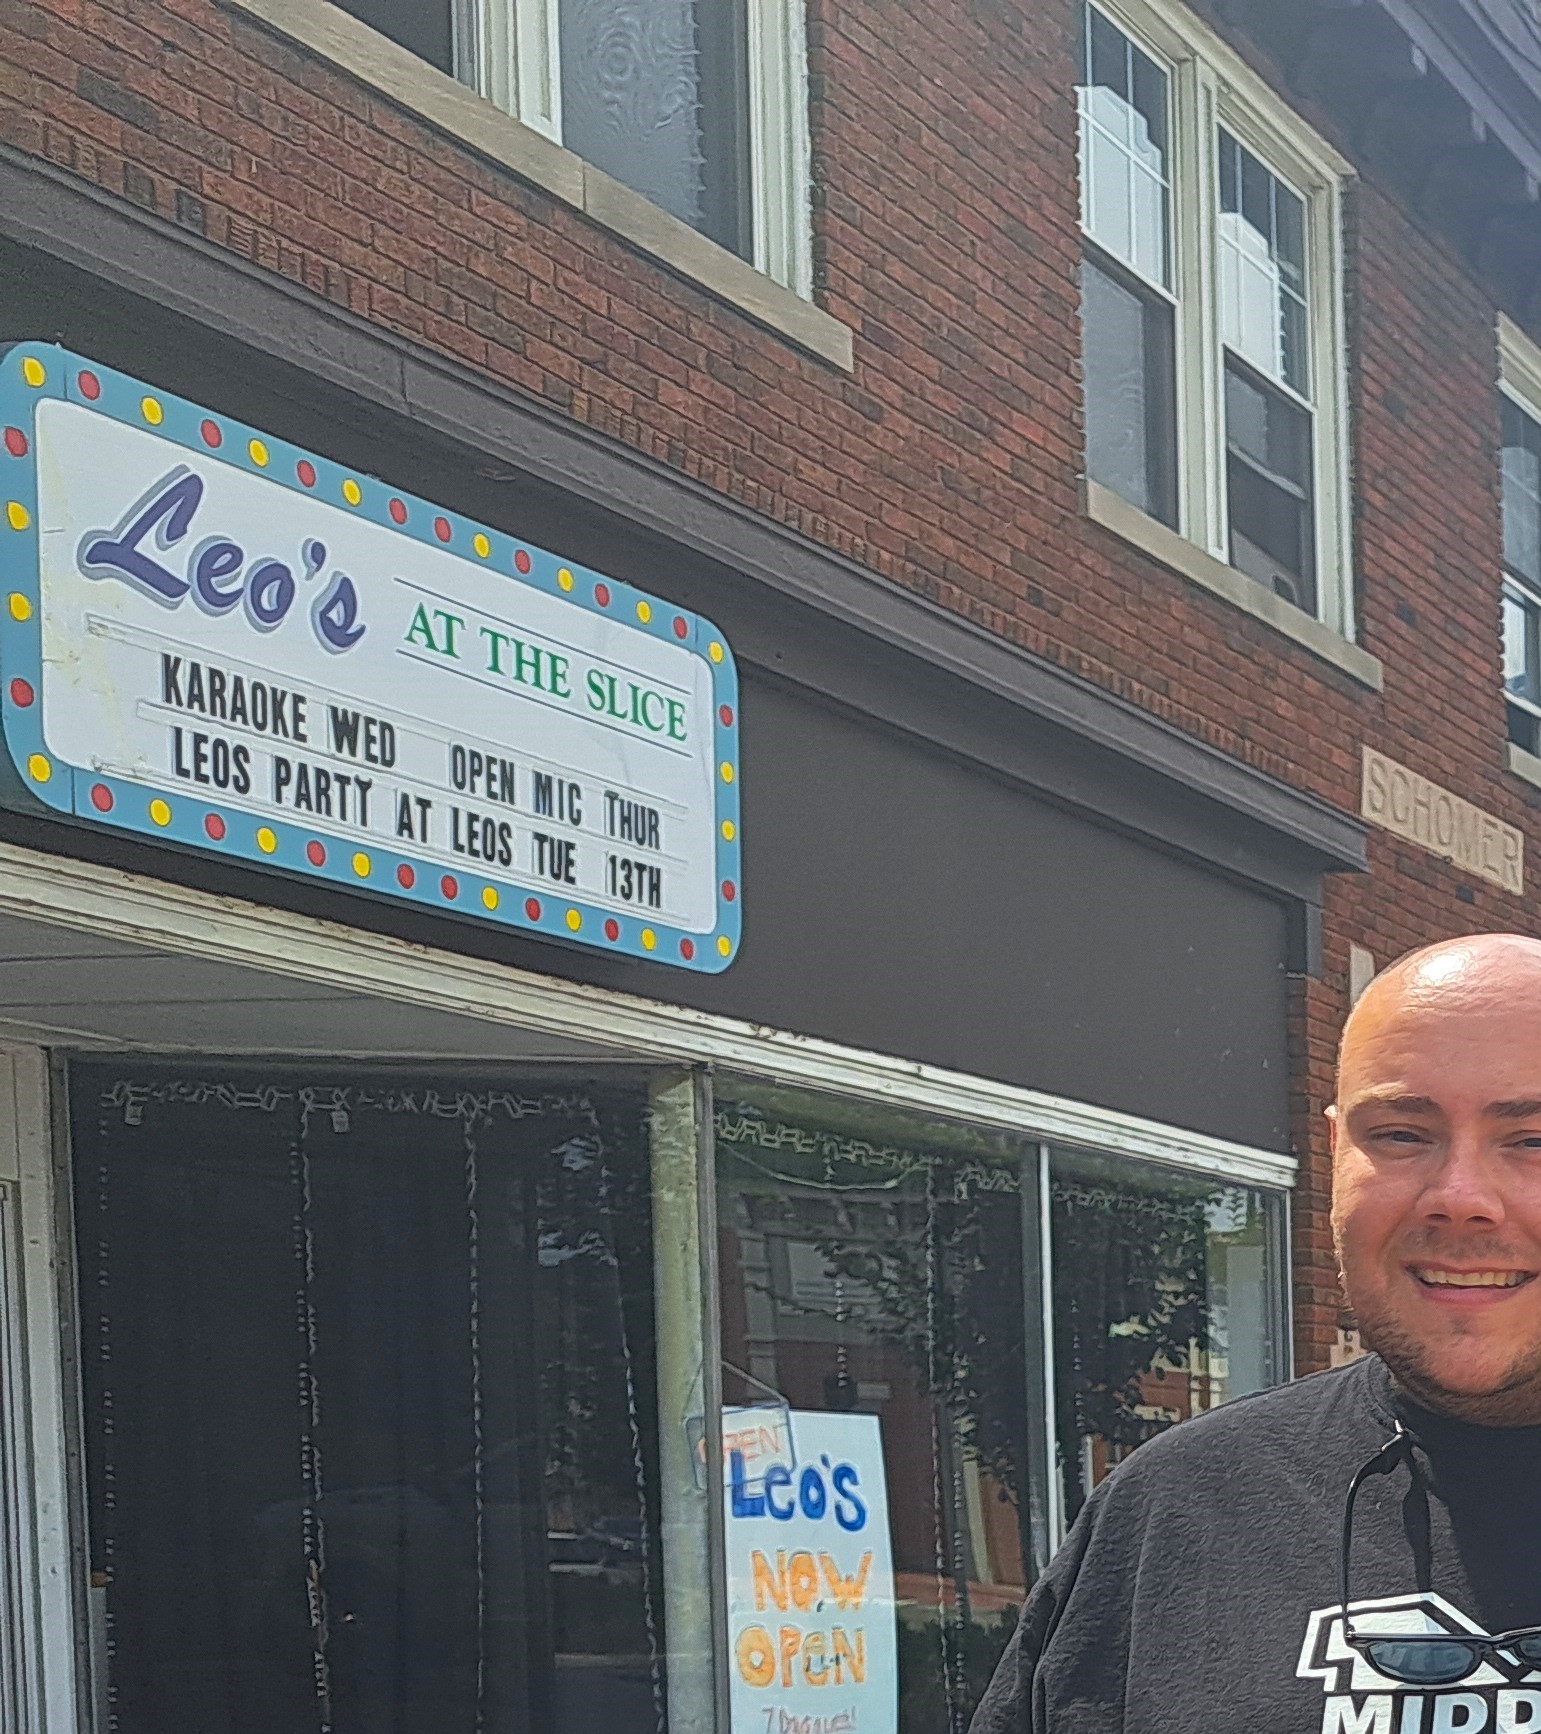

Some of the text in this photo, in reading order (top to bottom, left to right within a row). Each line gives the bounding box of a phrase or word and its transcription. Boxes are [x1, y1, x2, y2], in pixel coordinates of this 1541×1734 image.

[78, 464, 366, 655] Leo's
[403, 602, 689, 742] AT THE SLICE
[161, 652, 661, 850] KARAOKE WED OPEN MIC THUR
[172, 726, 662, 908] LEOS PARTY AT LEOS TUE 13TH
[698, 1424, 780, 1464] PEN
[751, 1549, 874, 1613] NOW
[736, 1624, 867, 1688] OPEN
